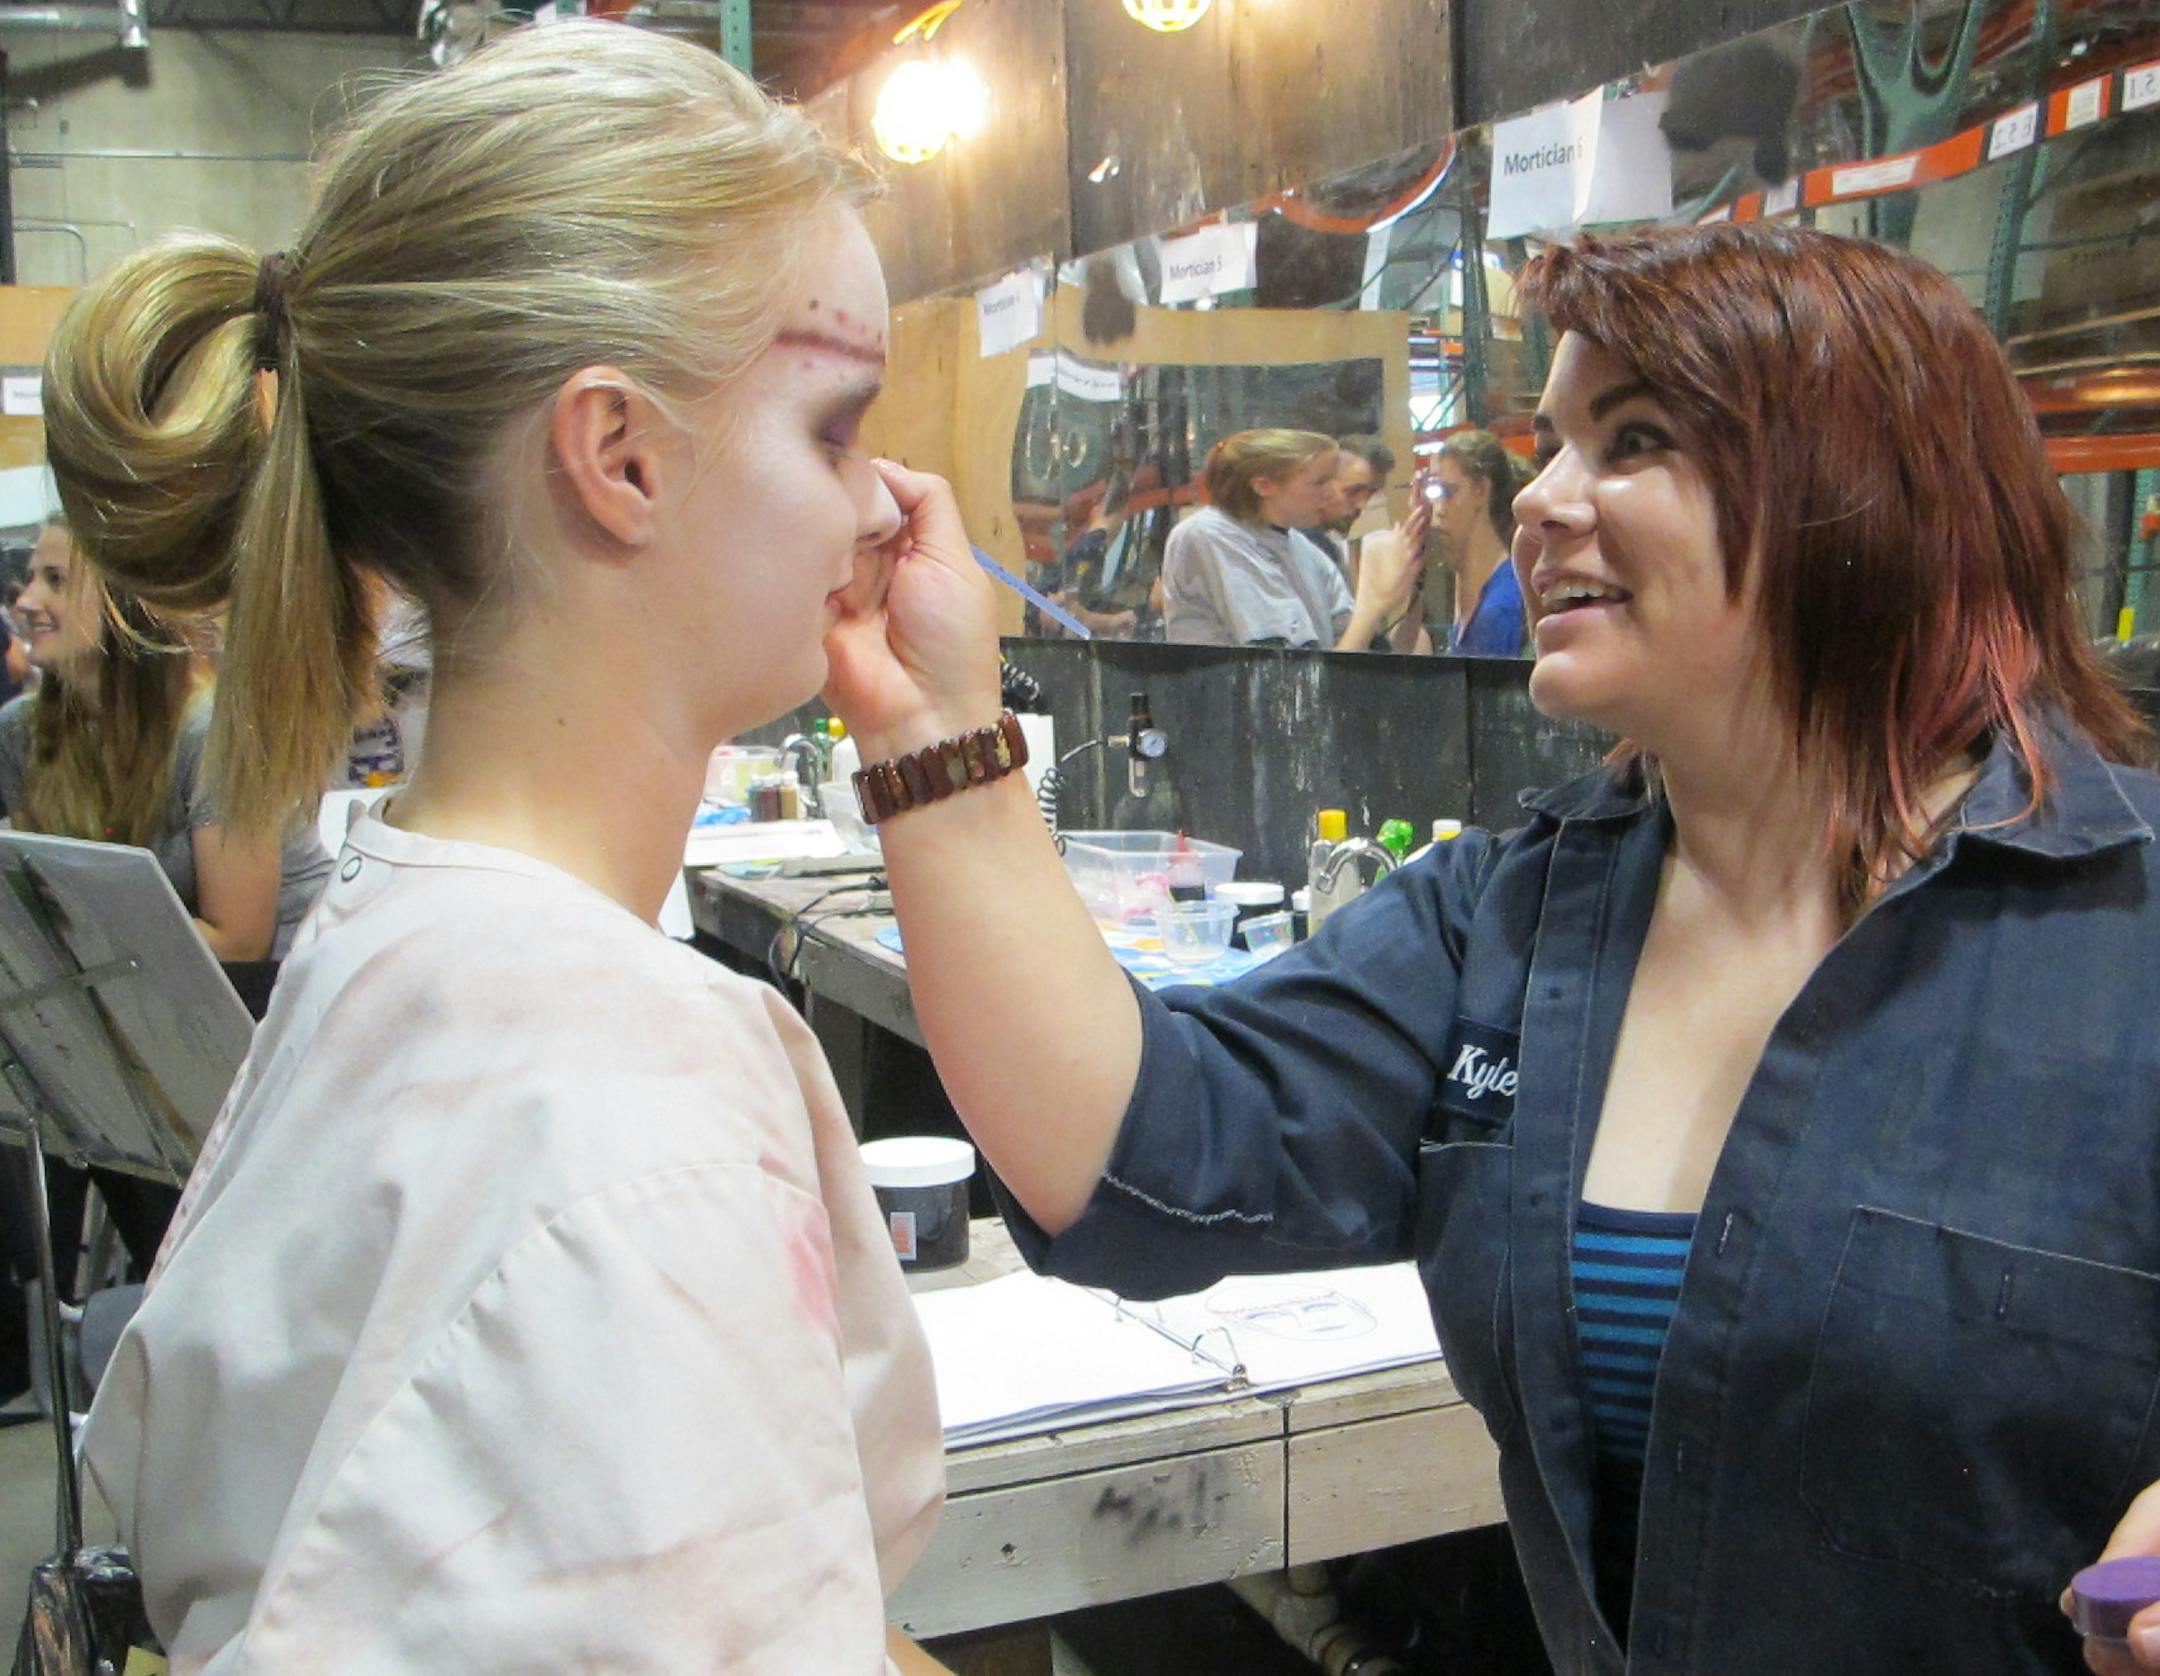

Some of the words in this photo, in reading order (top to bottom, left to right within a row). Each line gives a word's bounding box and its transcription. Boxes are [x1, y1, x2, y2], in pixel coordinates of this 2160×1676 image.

[1503, 142, 1575, 176] Mortician
[1169, 256, 1216, 279] Mortician
[1446, 1044, 1519, 1100] Kyle
